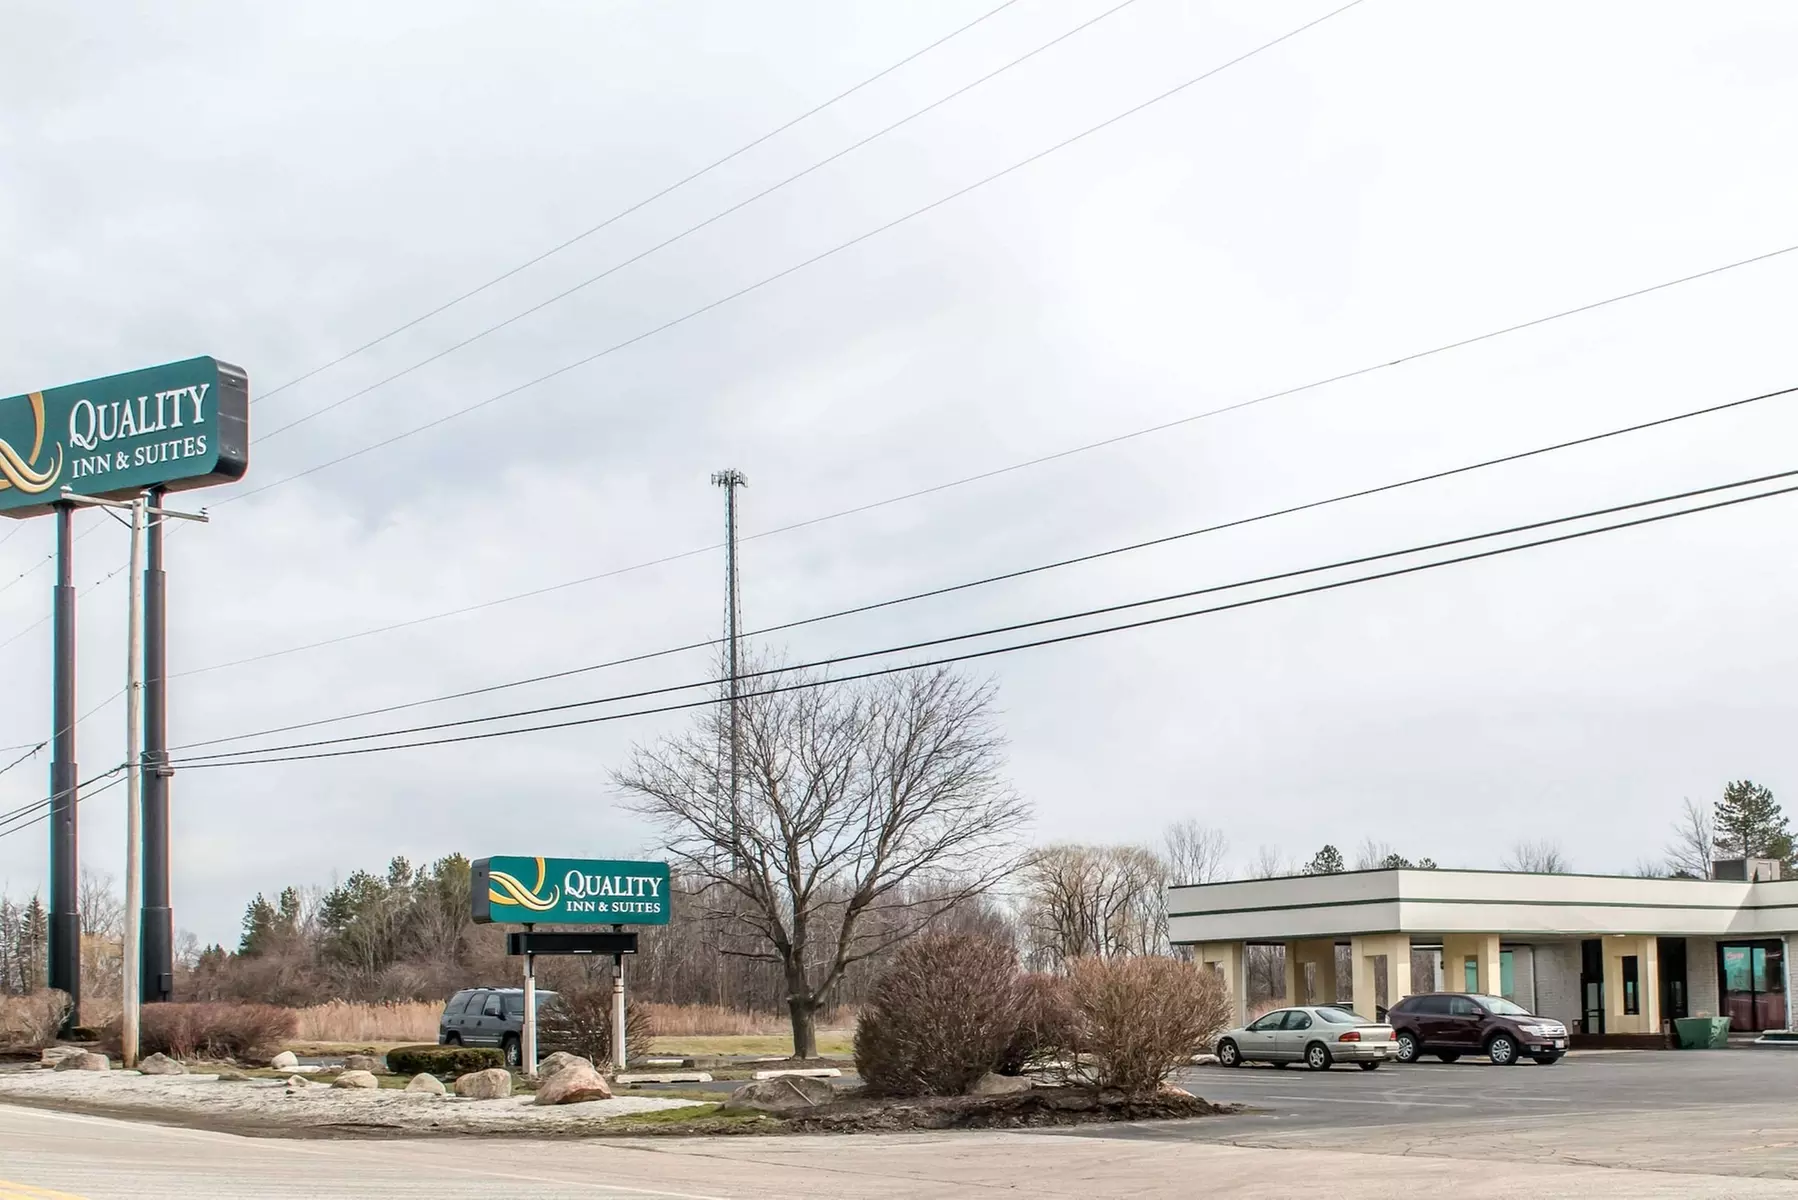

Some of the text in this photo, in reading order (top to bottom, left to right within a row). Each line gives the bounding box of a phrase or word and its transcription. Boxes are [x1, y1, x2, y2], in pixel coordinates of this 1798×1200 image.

[69, 384, 209, 450] QUALITY
[72, 435, 207, 478] INN & SUITES
[564, 870, 662, 898] QUALITY
[566, 901, 660, 912] INN & SUITES
